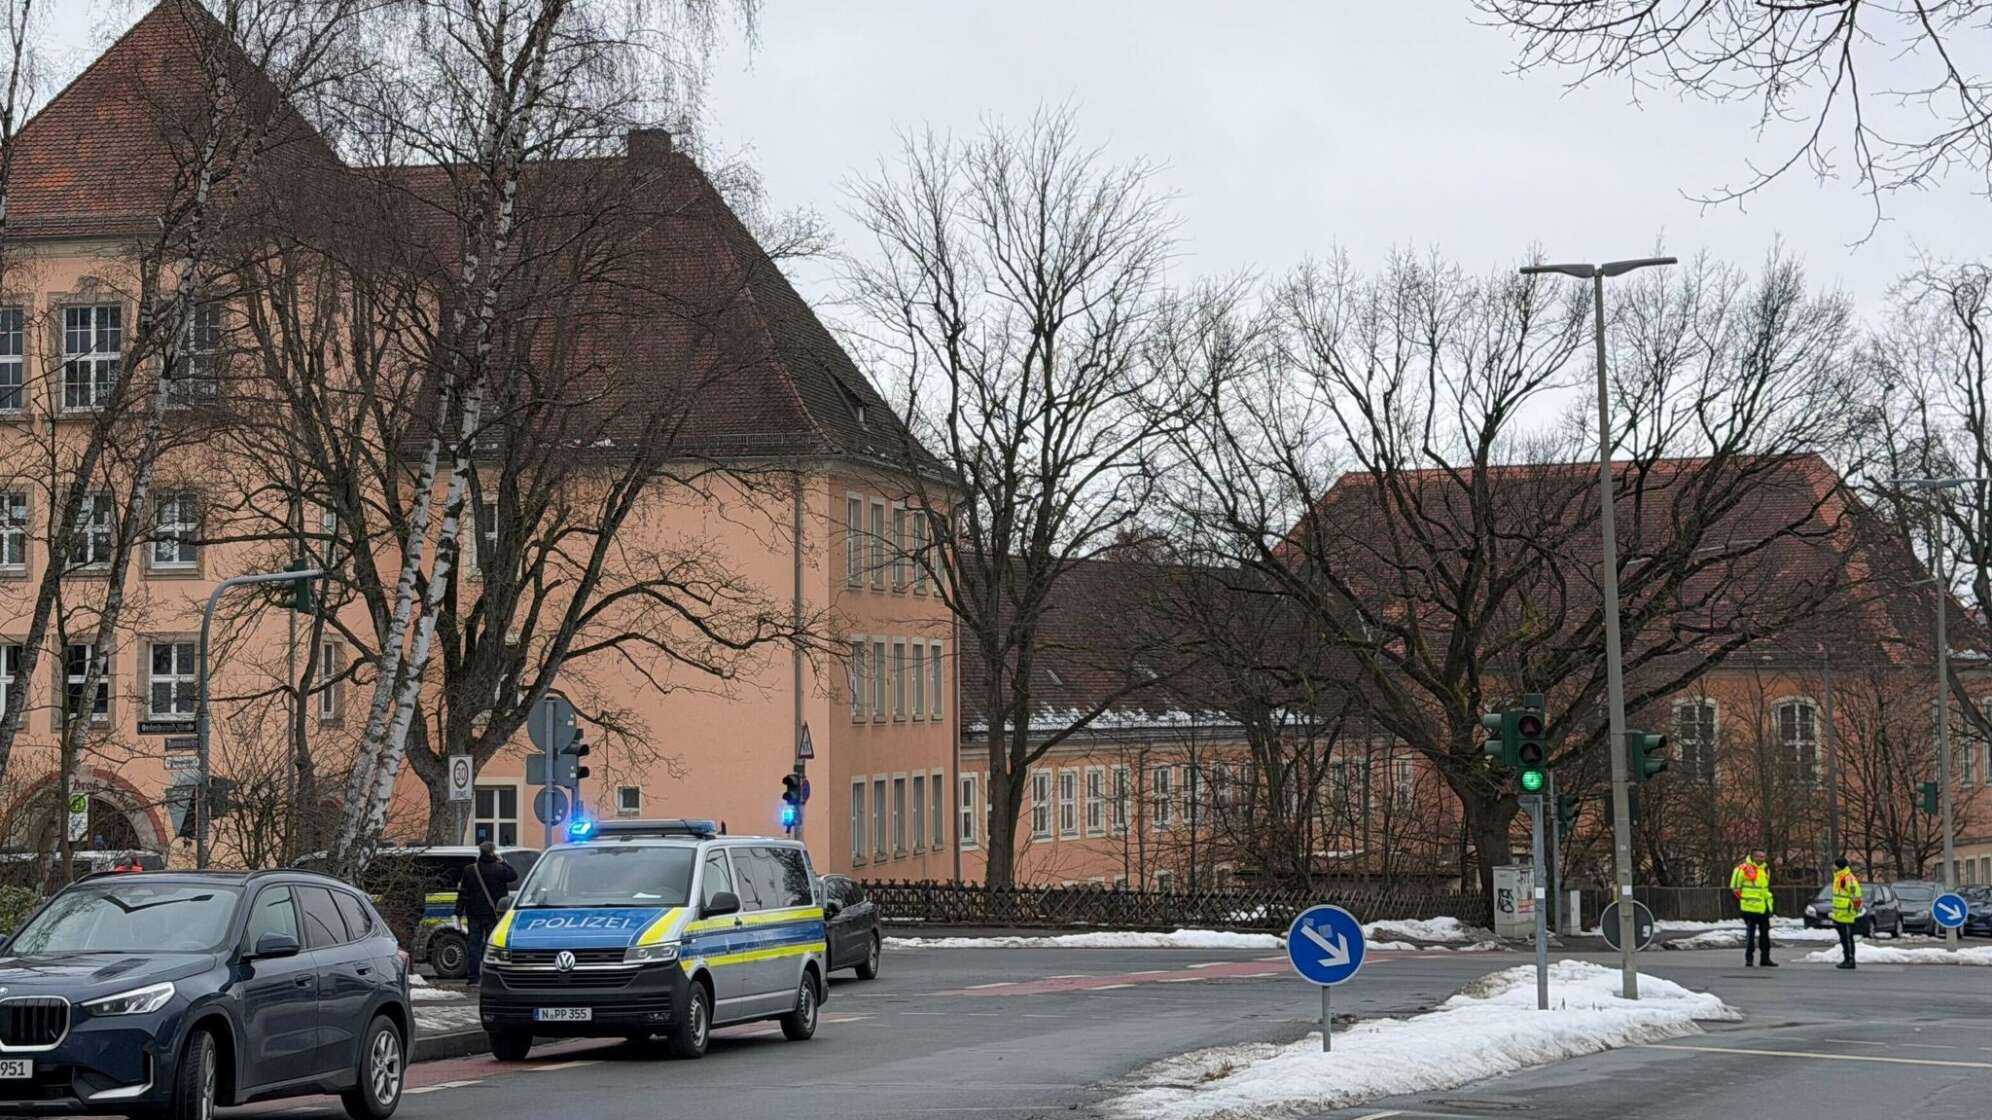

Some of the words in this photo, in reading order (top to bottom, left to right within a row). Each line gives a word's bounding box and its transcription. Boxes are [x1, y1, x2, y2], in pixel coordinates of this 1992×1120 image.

[456, 767, 467, 781] 30
[527, 916, 631, 930] POLIZEI
[569, 1009, 587, 1019] 355
[0, 1061, 26, 1076] 951
